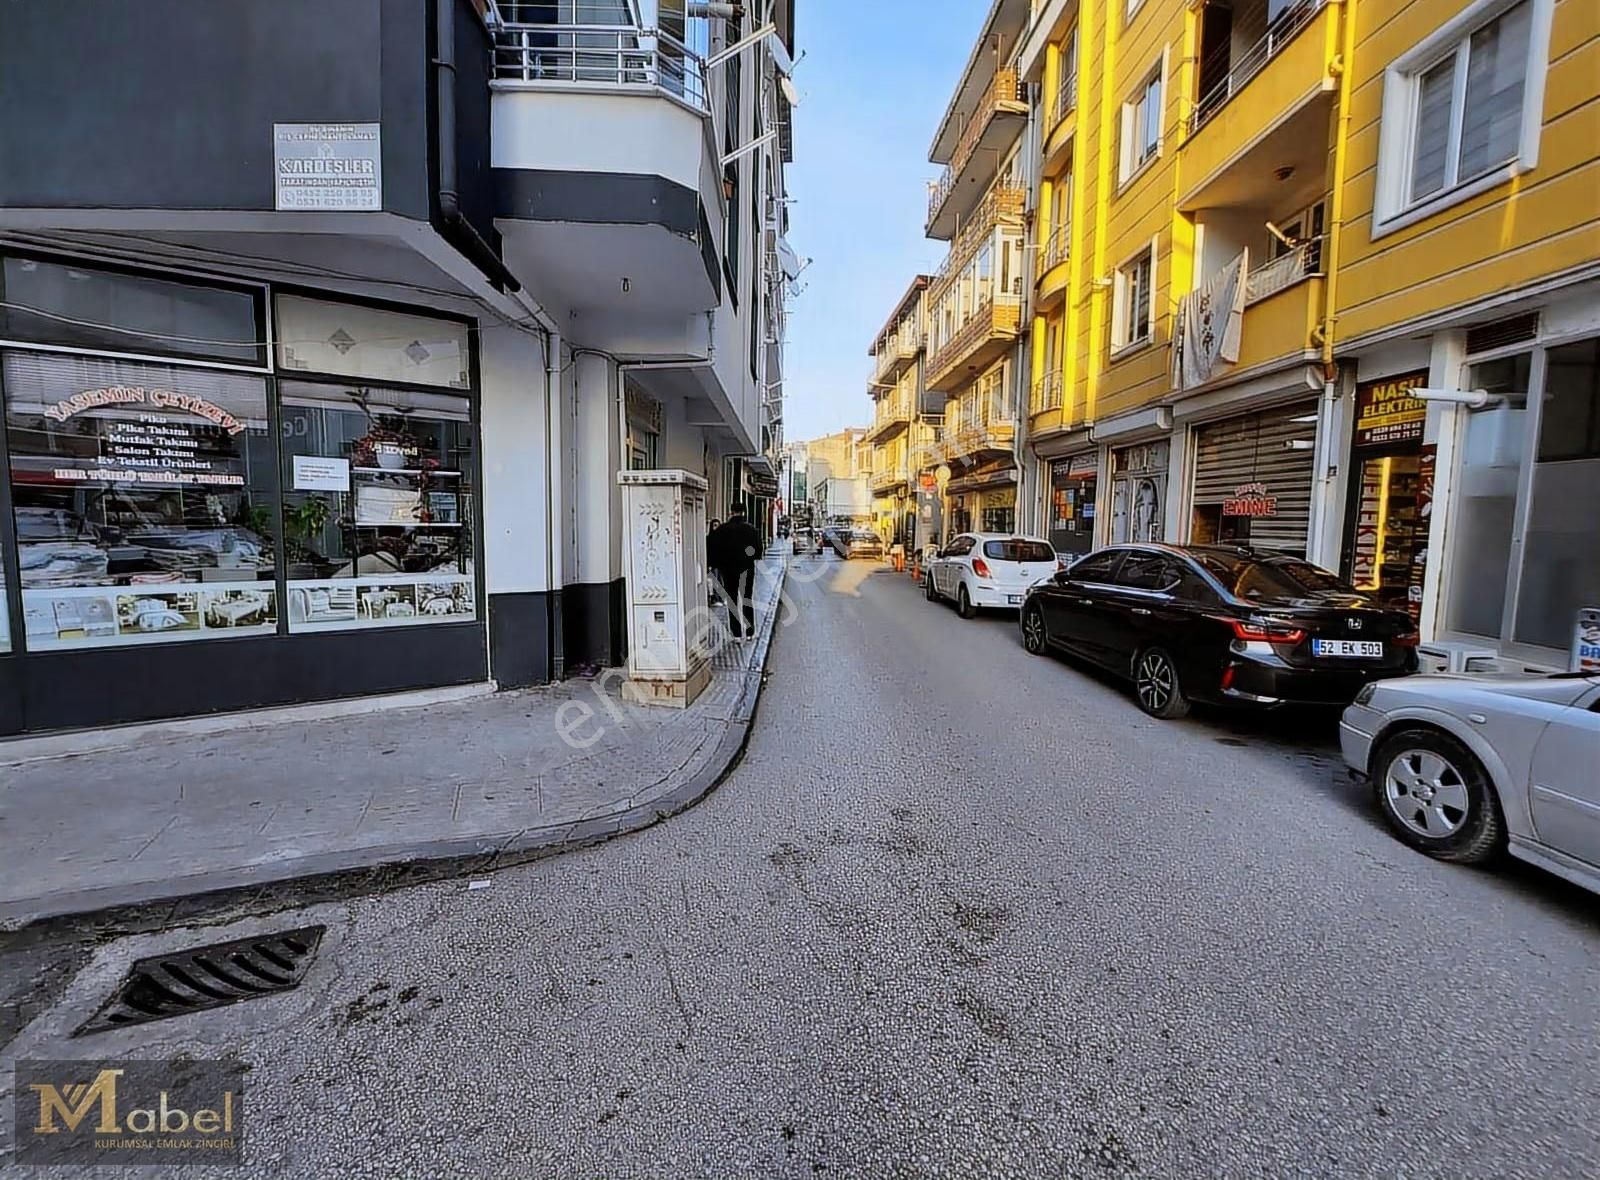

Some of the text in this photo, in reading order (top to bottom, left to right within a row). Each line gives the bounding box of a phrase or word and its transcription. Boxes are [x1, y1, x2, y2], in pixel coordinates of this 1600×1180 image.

[118, 423, 146, 434] Pike
[109, 434, 155, 445] Mutfak
[114, 445, 150, 456] Salon
[119, 456, 159, 468] Tekstil
[1320, 642, 1381, 655] 52 EK 503
